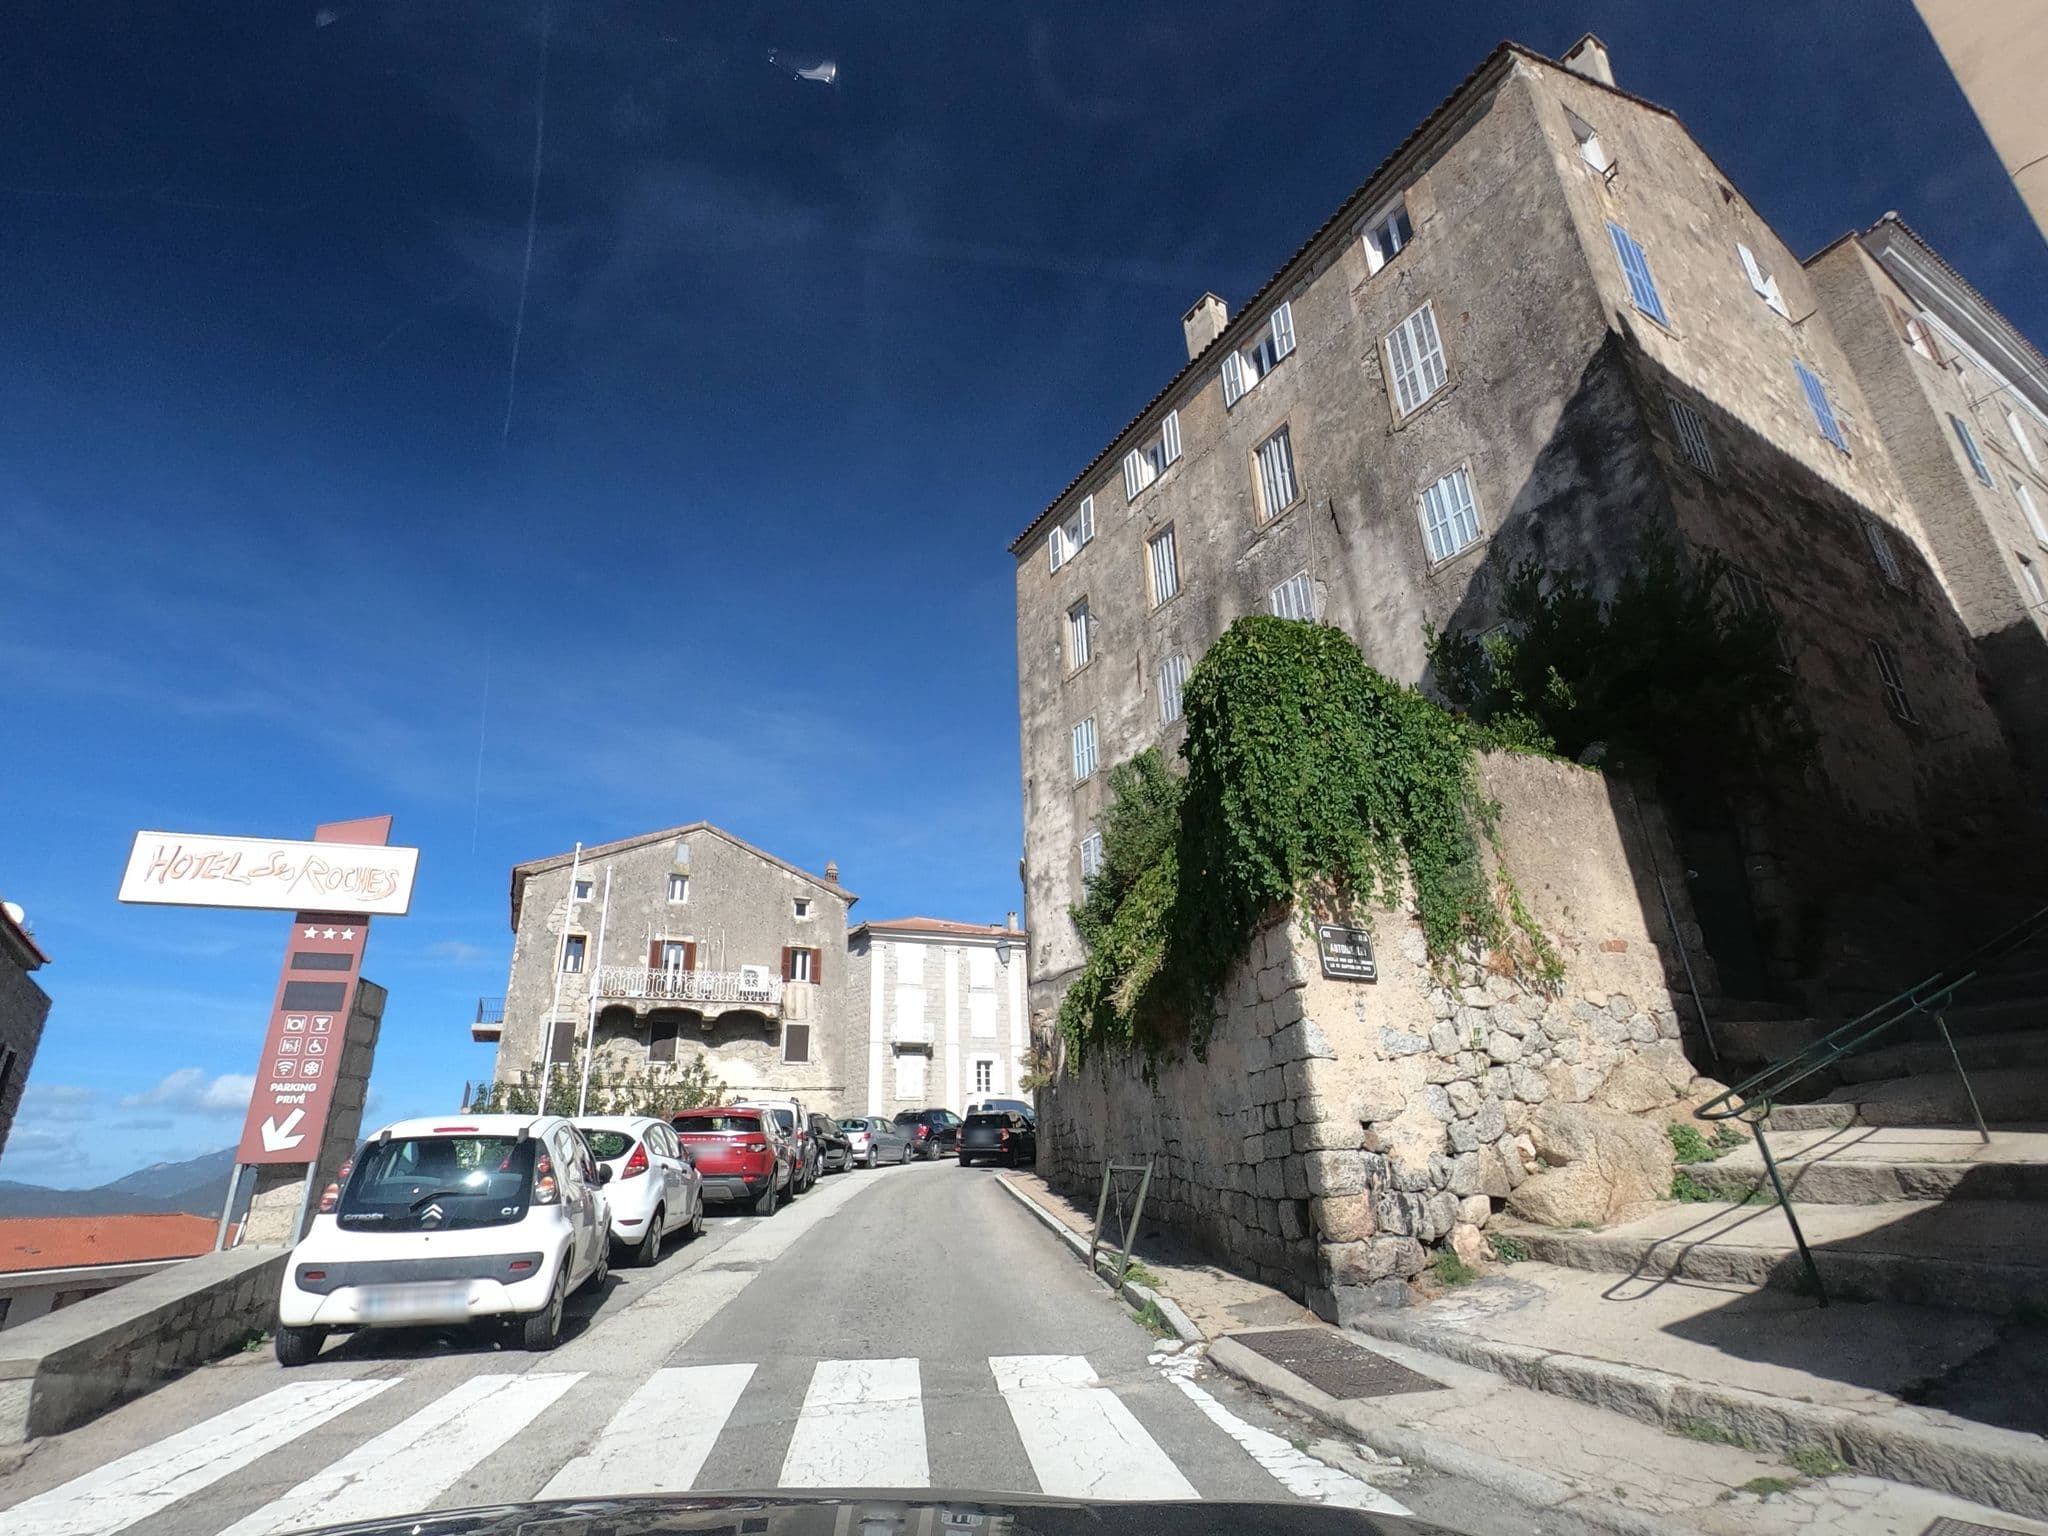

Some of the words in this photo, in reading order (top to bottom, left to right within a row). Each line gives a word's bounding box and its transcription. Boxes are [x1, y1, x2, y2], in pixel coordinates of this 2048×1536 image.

[144, 845, 251, 886] HOTEL
[286, 854, 400, 902] ROCHES
[270, 1083, 317, 1092] PARKING
[275, 1092, 306, 1104] PRIVÉ
[500, 1206, 520, 1216] C1
